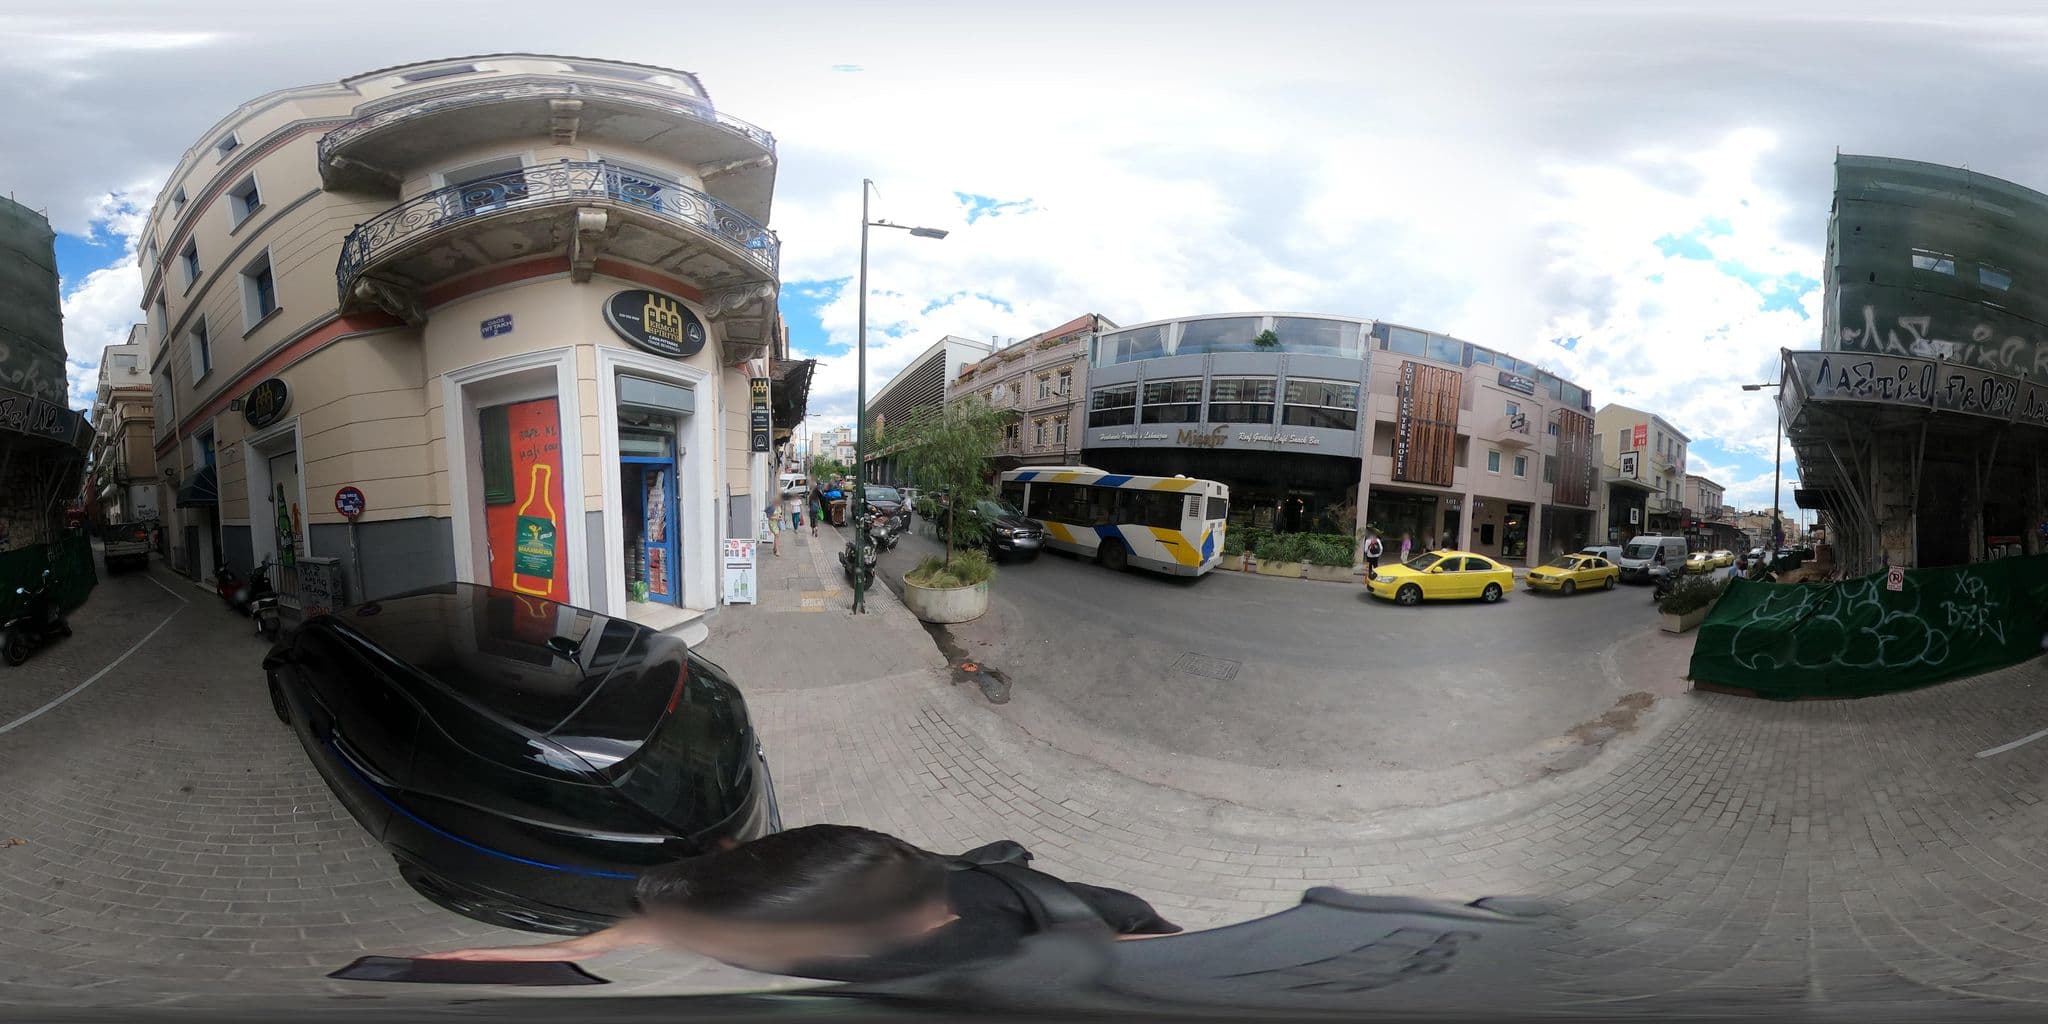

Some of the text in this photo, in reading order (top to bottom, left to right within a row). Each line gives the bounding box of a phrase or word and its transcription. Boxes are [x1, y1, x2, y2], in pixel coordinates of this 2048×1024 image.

[649, 320, 678, 334] ERMOU
[1397, 362, 1414, 475] LOTUS CENTER HOTEL
[1238, 431, 1251, 442] Roof
[1253, 432, 1273, 443] Garden
[1290, 434, 1307, 444] Snack
[1308, 435, 1320, 445] Bar
